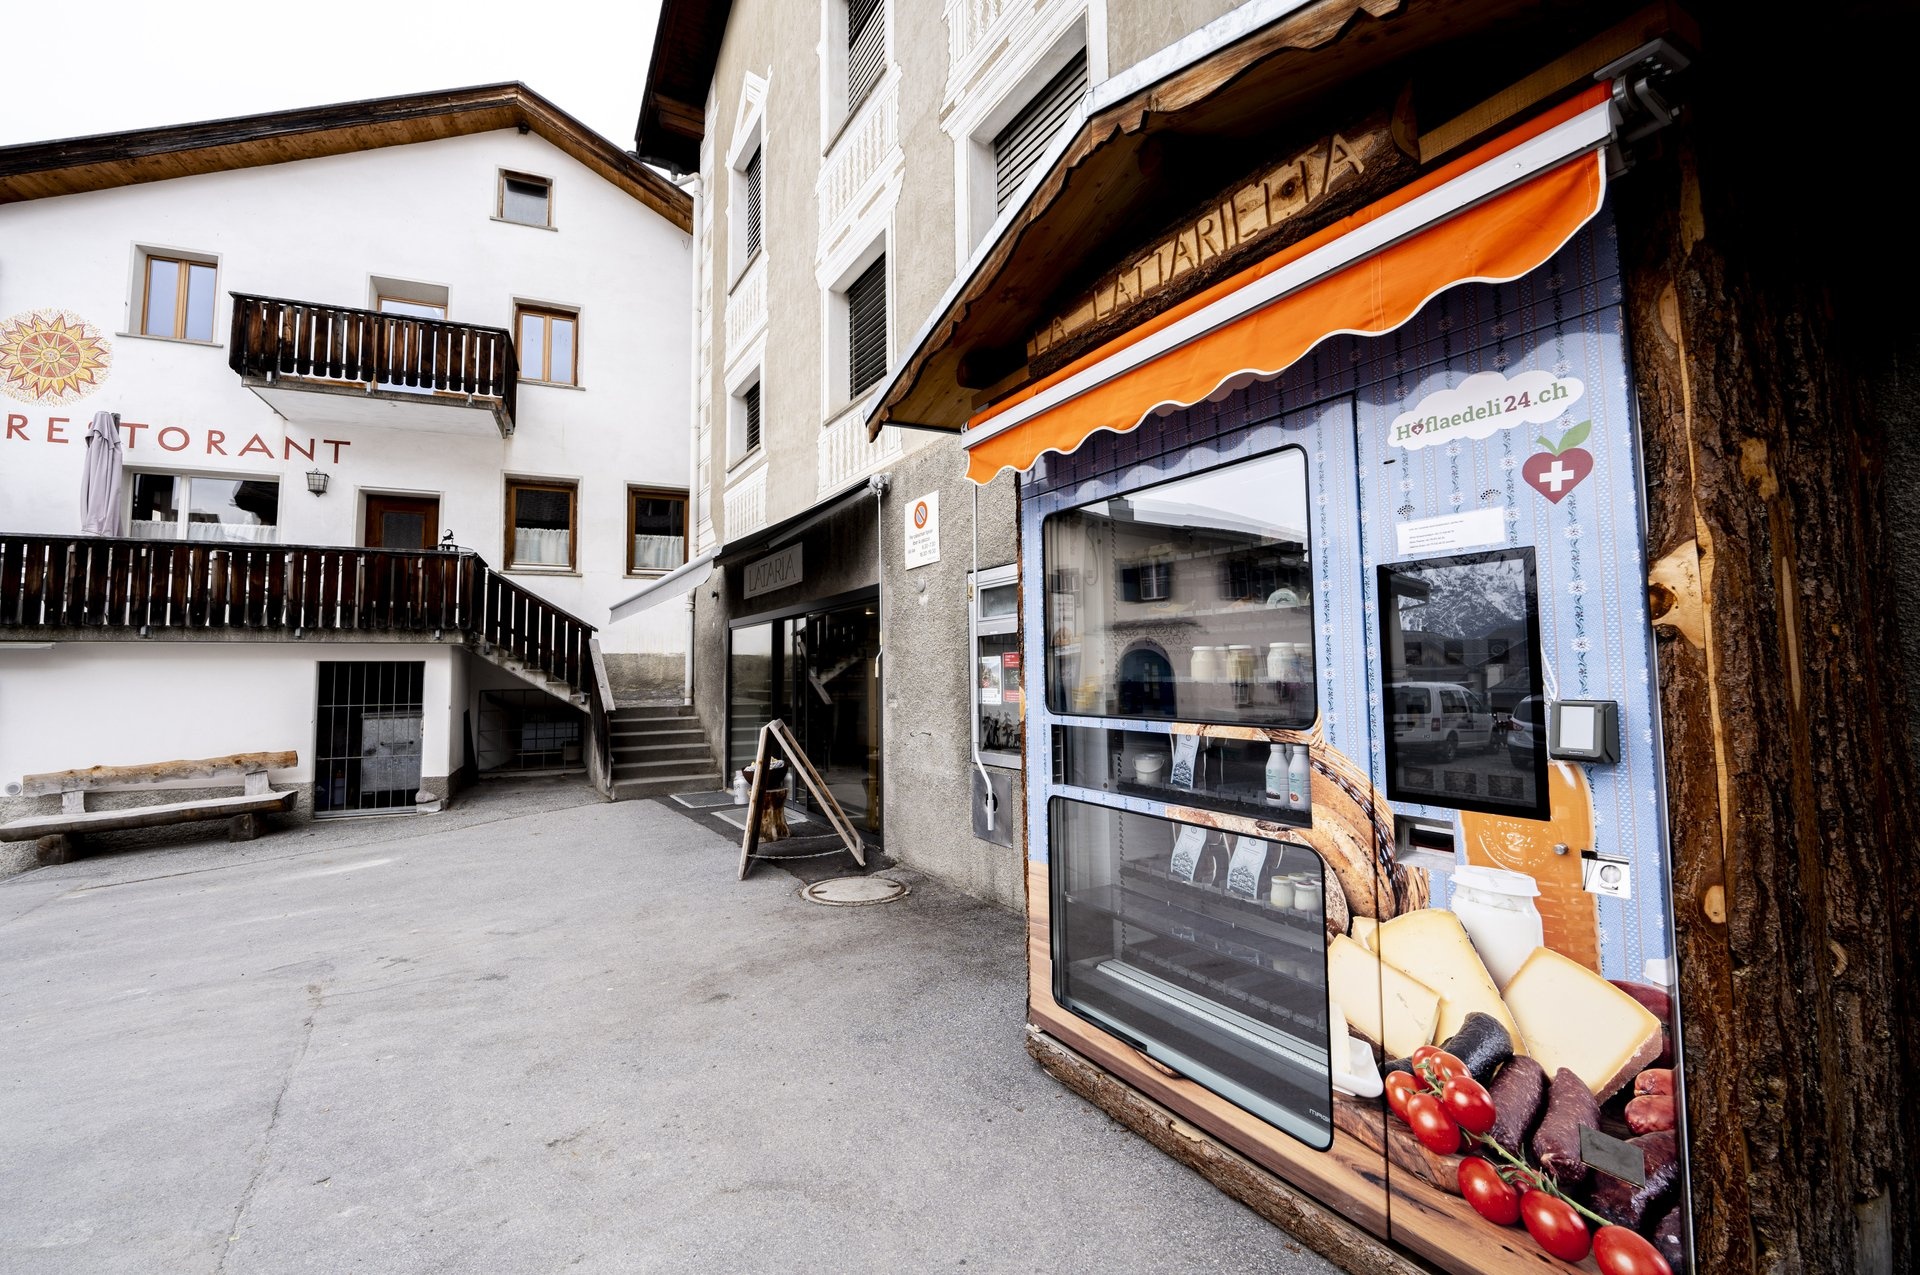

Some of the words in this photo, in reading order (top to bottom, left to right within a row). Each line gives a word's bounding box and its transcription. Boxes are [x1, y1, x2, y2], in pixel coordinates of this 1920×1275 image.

[1033, 316, 1069, 357] LA
[6, 413, 352, 465] RETORANT
[748, 552, 797, 592] LATARIA
